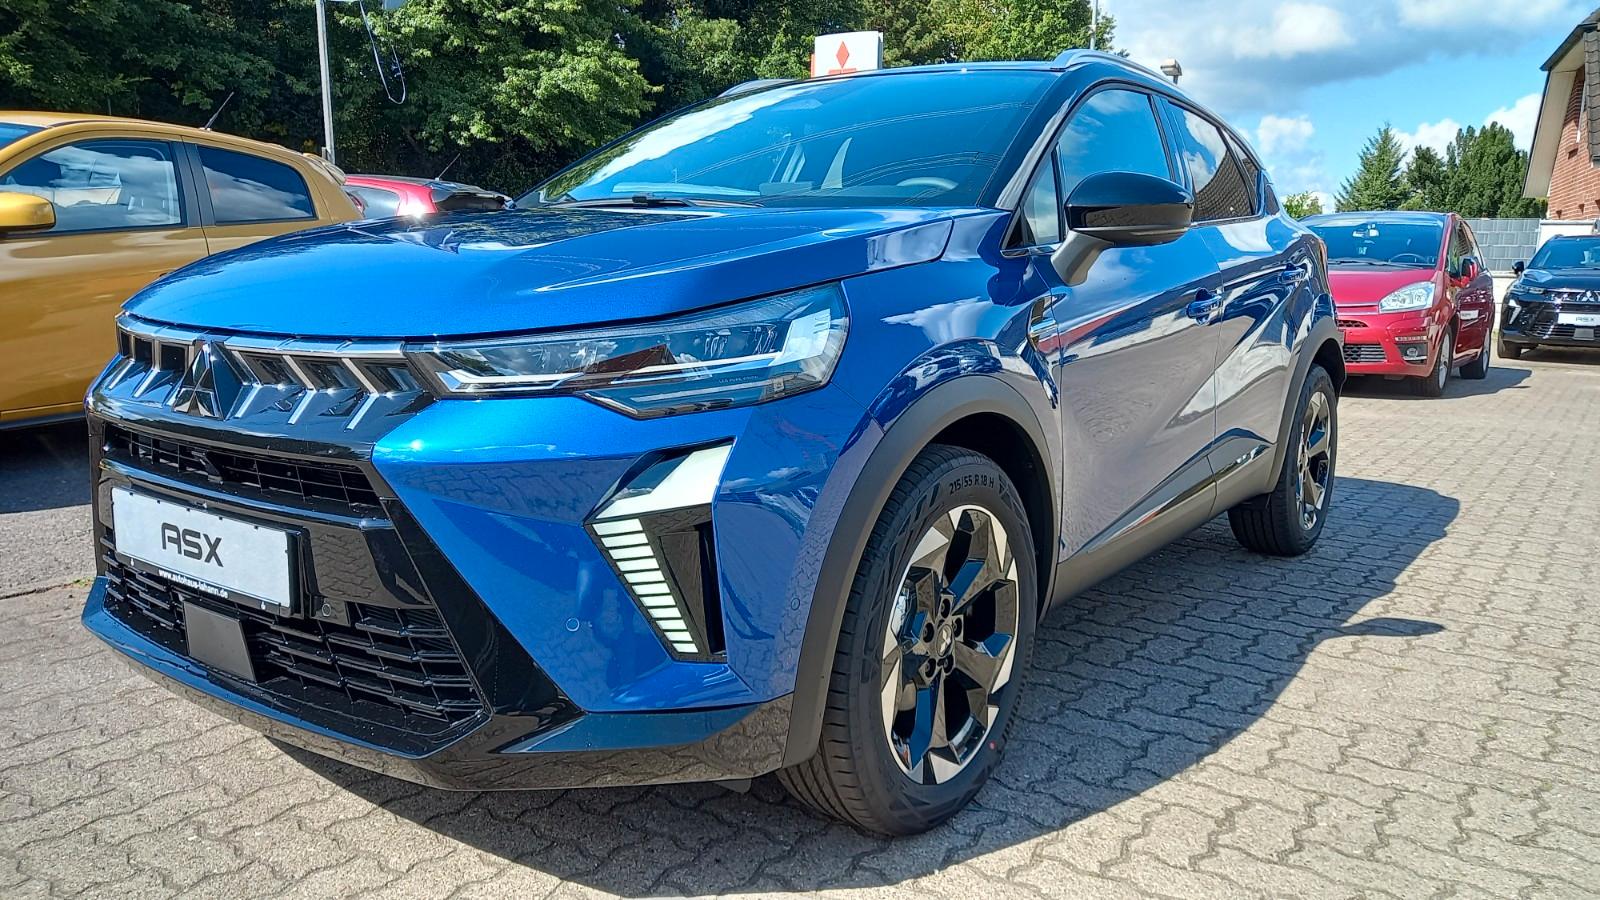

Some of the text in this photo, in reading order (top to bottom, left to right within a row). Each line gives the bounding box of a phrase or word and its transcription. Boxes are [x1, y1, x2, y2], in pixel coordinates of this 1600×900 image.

[949, 474, 995, 495] 215/55 R 18 H
[161, 522, 224, 568] ASX
